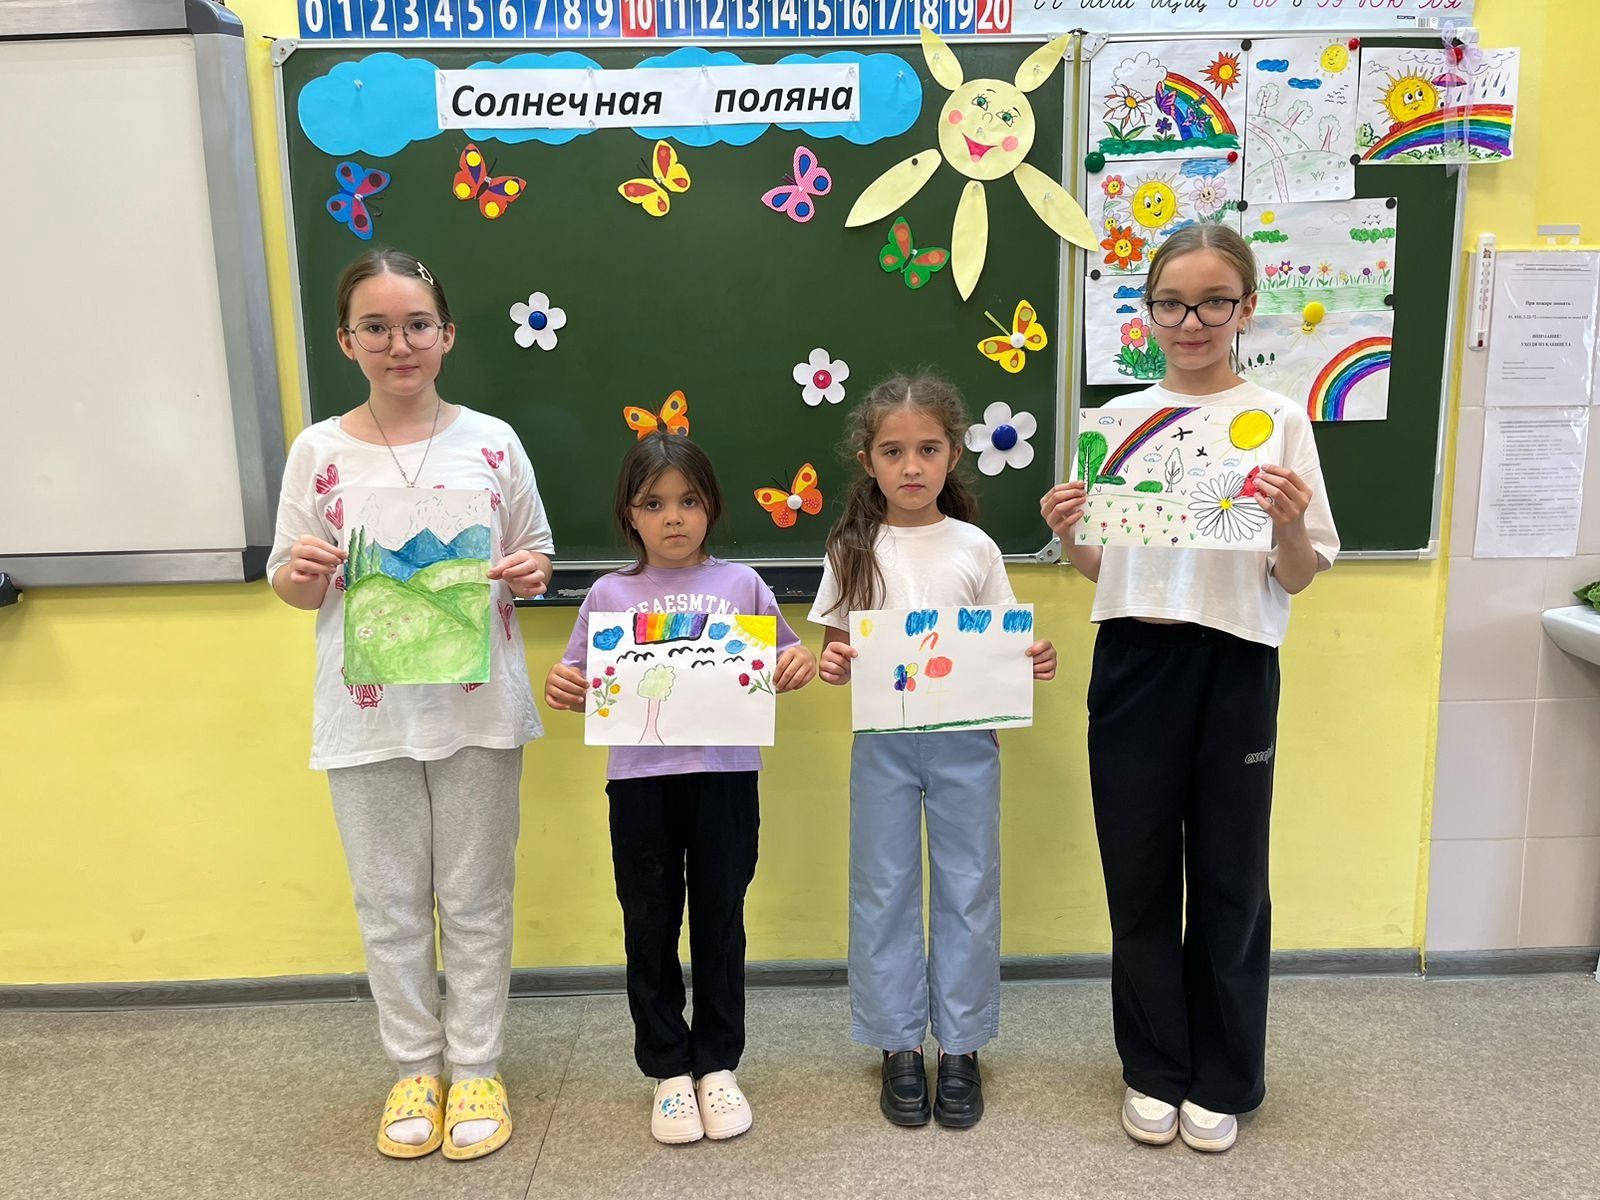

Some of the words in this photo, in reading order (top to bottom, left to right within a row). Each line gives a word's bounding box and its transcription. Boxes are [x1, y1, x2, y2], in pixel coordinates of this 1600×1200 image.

[306, 0, 323, 32] 0
[338, 0, 353, 31] 1
[371, 0, 388, 31] 2
[403, 0, 419, 31] 3
[435, 0, 453, 30] 4
[468, 0, 484, 30] 5
[500, 0, 517, 30] 6
[533, 0, 547, 30] 7
[564, 0, 581, 30] 8
[596, 0, 613, 29] 9
[627, 0, 653, 29] 10
[663, 0, 686, 29] 11
[699, 0, 725, 29] 12
[735, 0, 760, 29] 13
[770, 0, 798, 29] 14
[806, 0, 832, 29] 15
[842, 0, 869, 29] 16
[877, 0, 902, 29] 17
[912, 0, 940, 29] 18
[947, 0, 974, 29] 19
[978, 0, 1010, 29] 20
[452, 85, 663, 117] Солнечная
[714, 86, 851, 113] поляна
